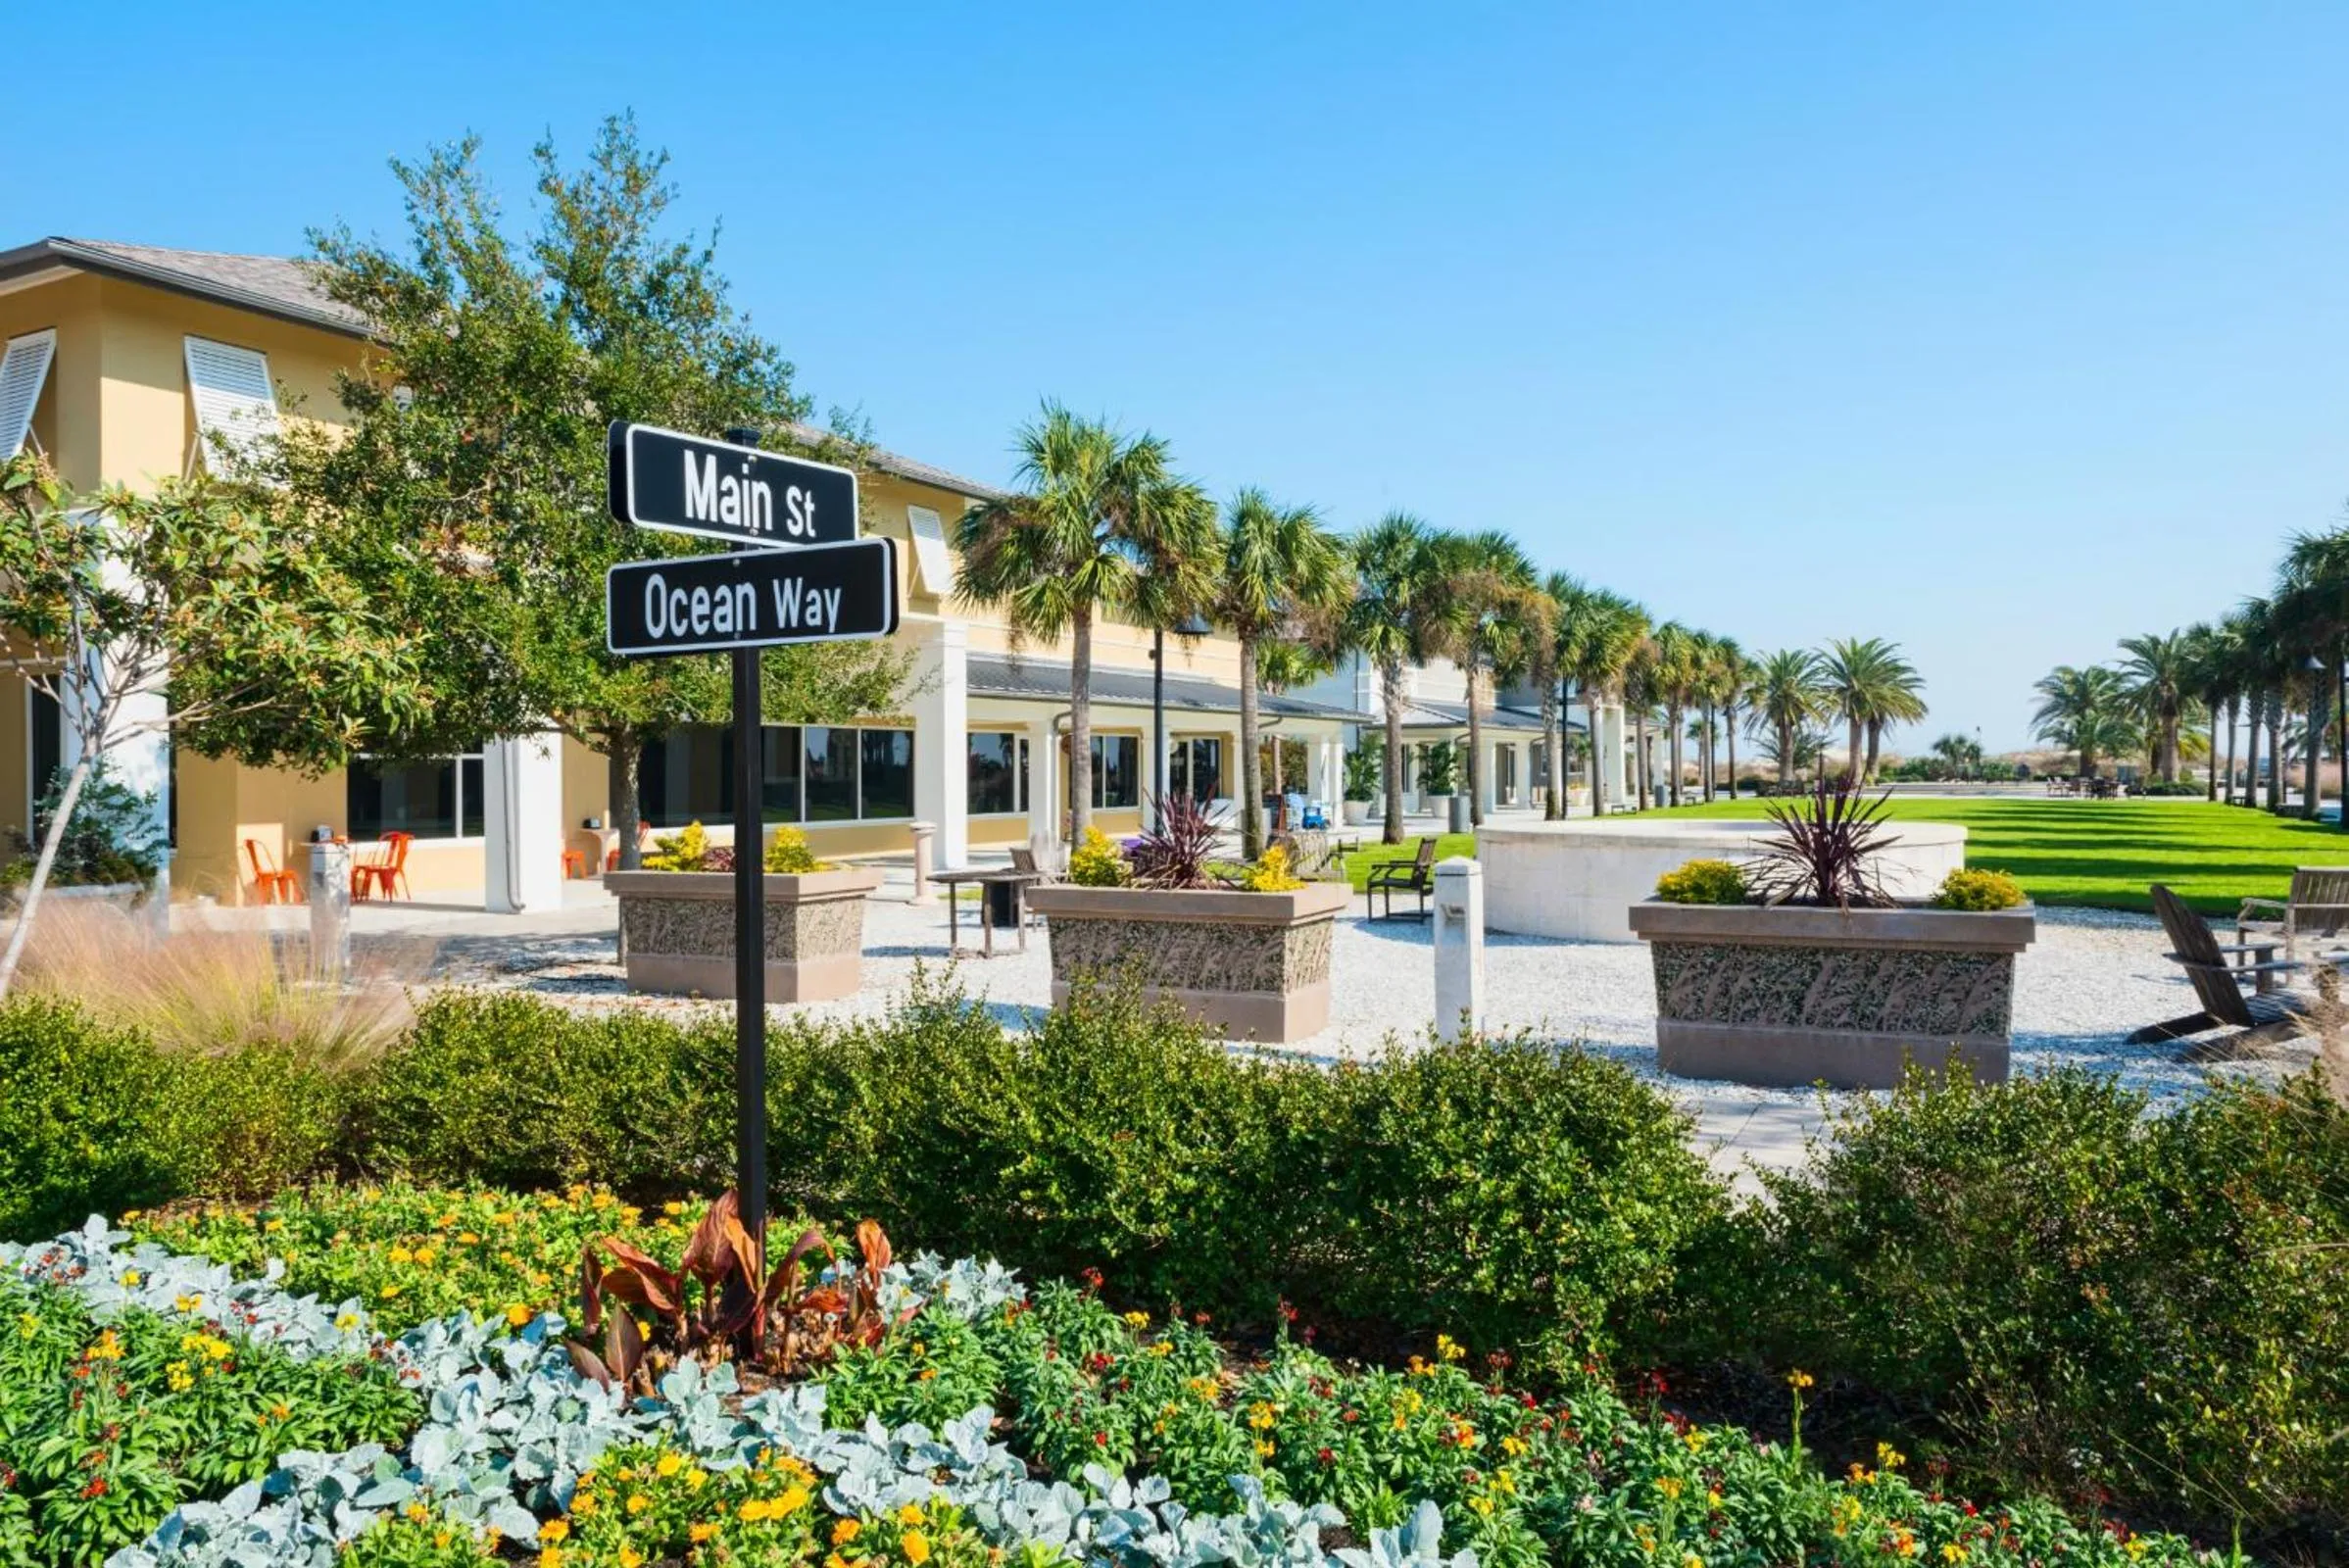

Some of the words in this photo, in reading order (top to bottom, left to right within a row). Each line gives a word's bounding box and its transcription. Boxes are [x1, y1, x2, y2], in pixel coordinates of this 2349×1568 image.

[684, 450, 772, 530] Main
[786, 485, 815, 537] St
[645, 573, 757, 638] Ocean
[772, 577, 841, 633] Way
